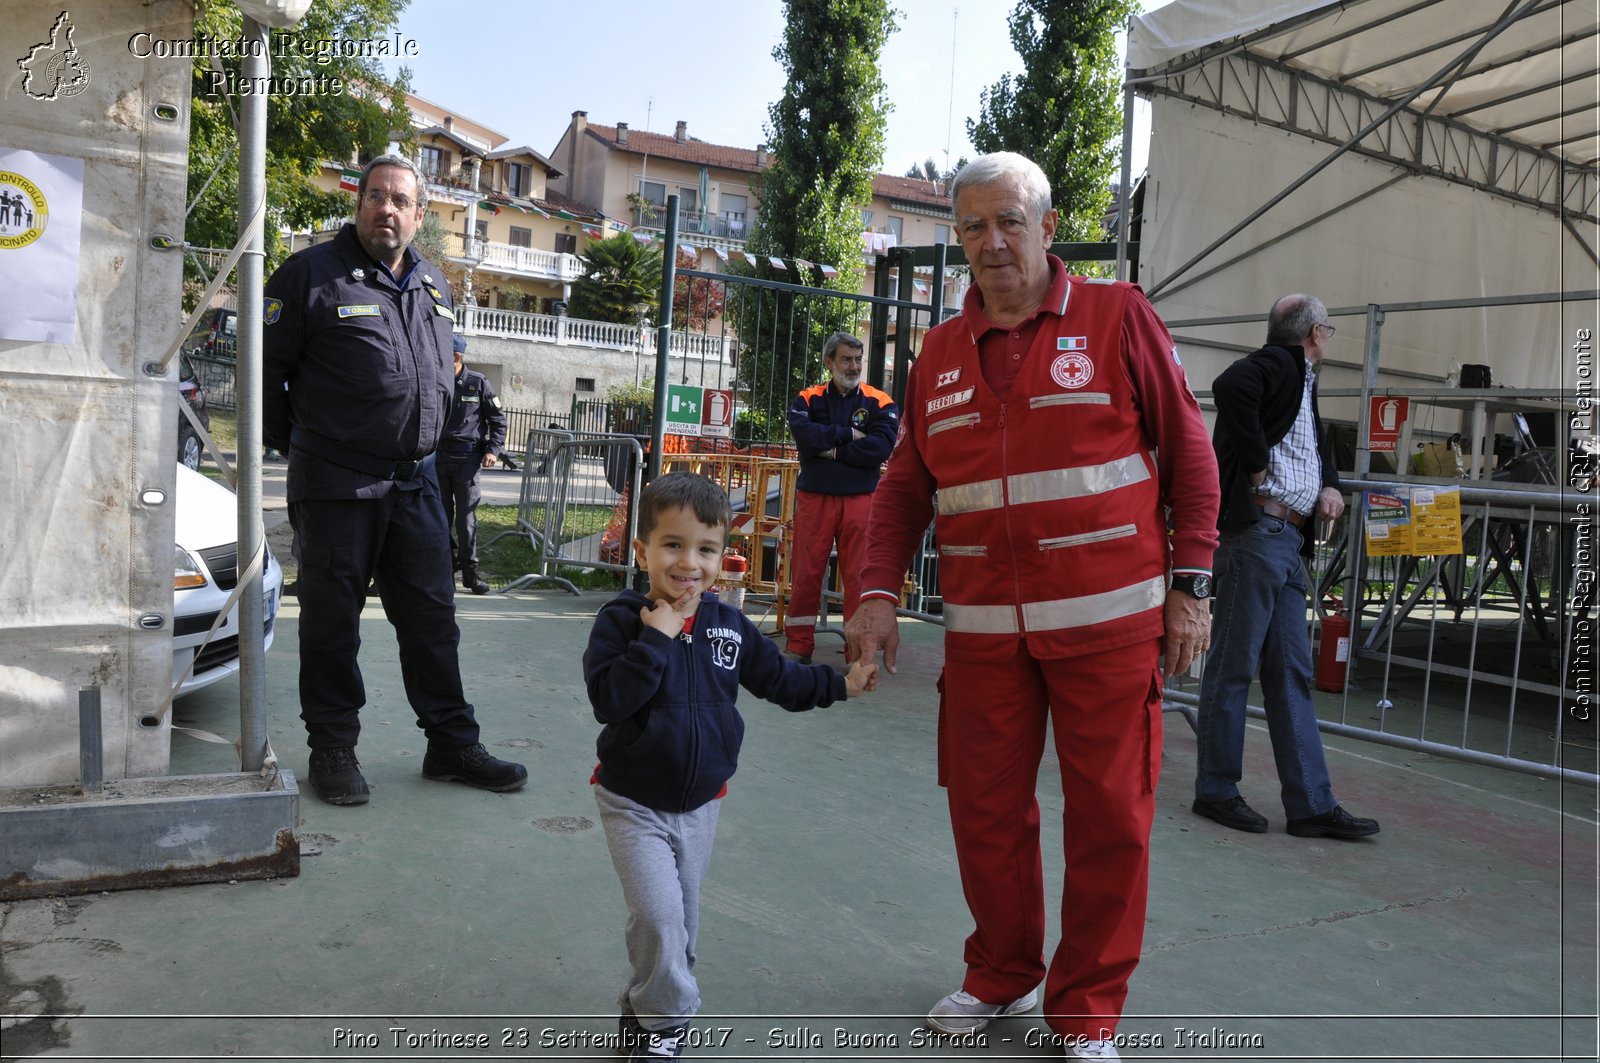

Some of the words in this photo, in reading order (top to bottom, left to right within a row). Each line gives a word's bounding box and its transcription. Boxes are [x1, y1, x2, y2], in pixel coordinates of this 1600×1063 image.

[0, 173, 44, 208] ONTROLLO
[0, 229, 37, 247] ICINATO
[345, 306, 375, 315] TORINO
[930, 394, 956, 411] SERGIO
[960, 391, 968, 401] T.
[666, 427, 698, 435] EMERGENZA
[706, 627, 742, 645] CHAMPION
[711, 637, 740, 670] 19
